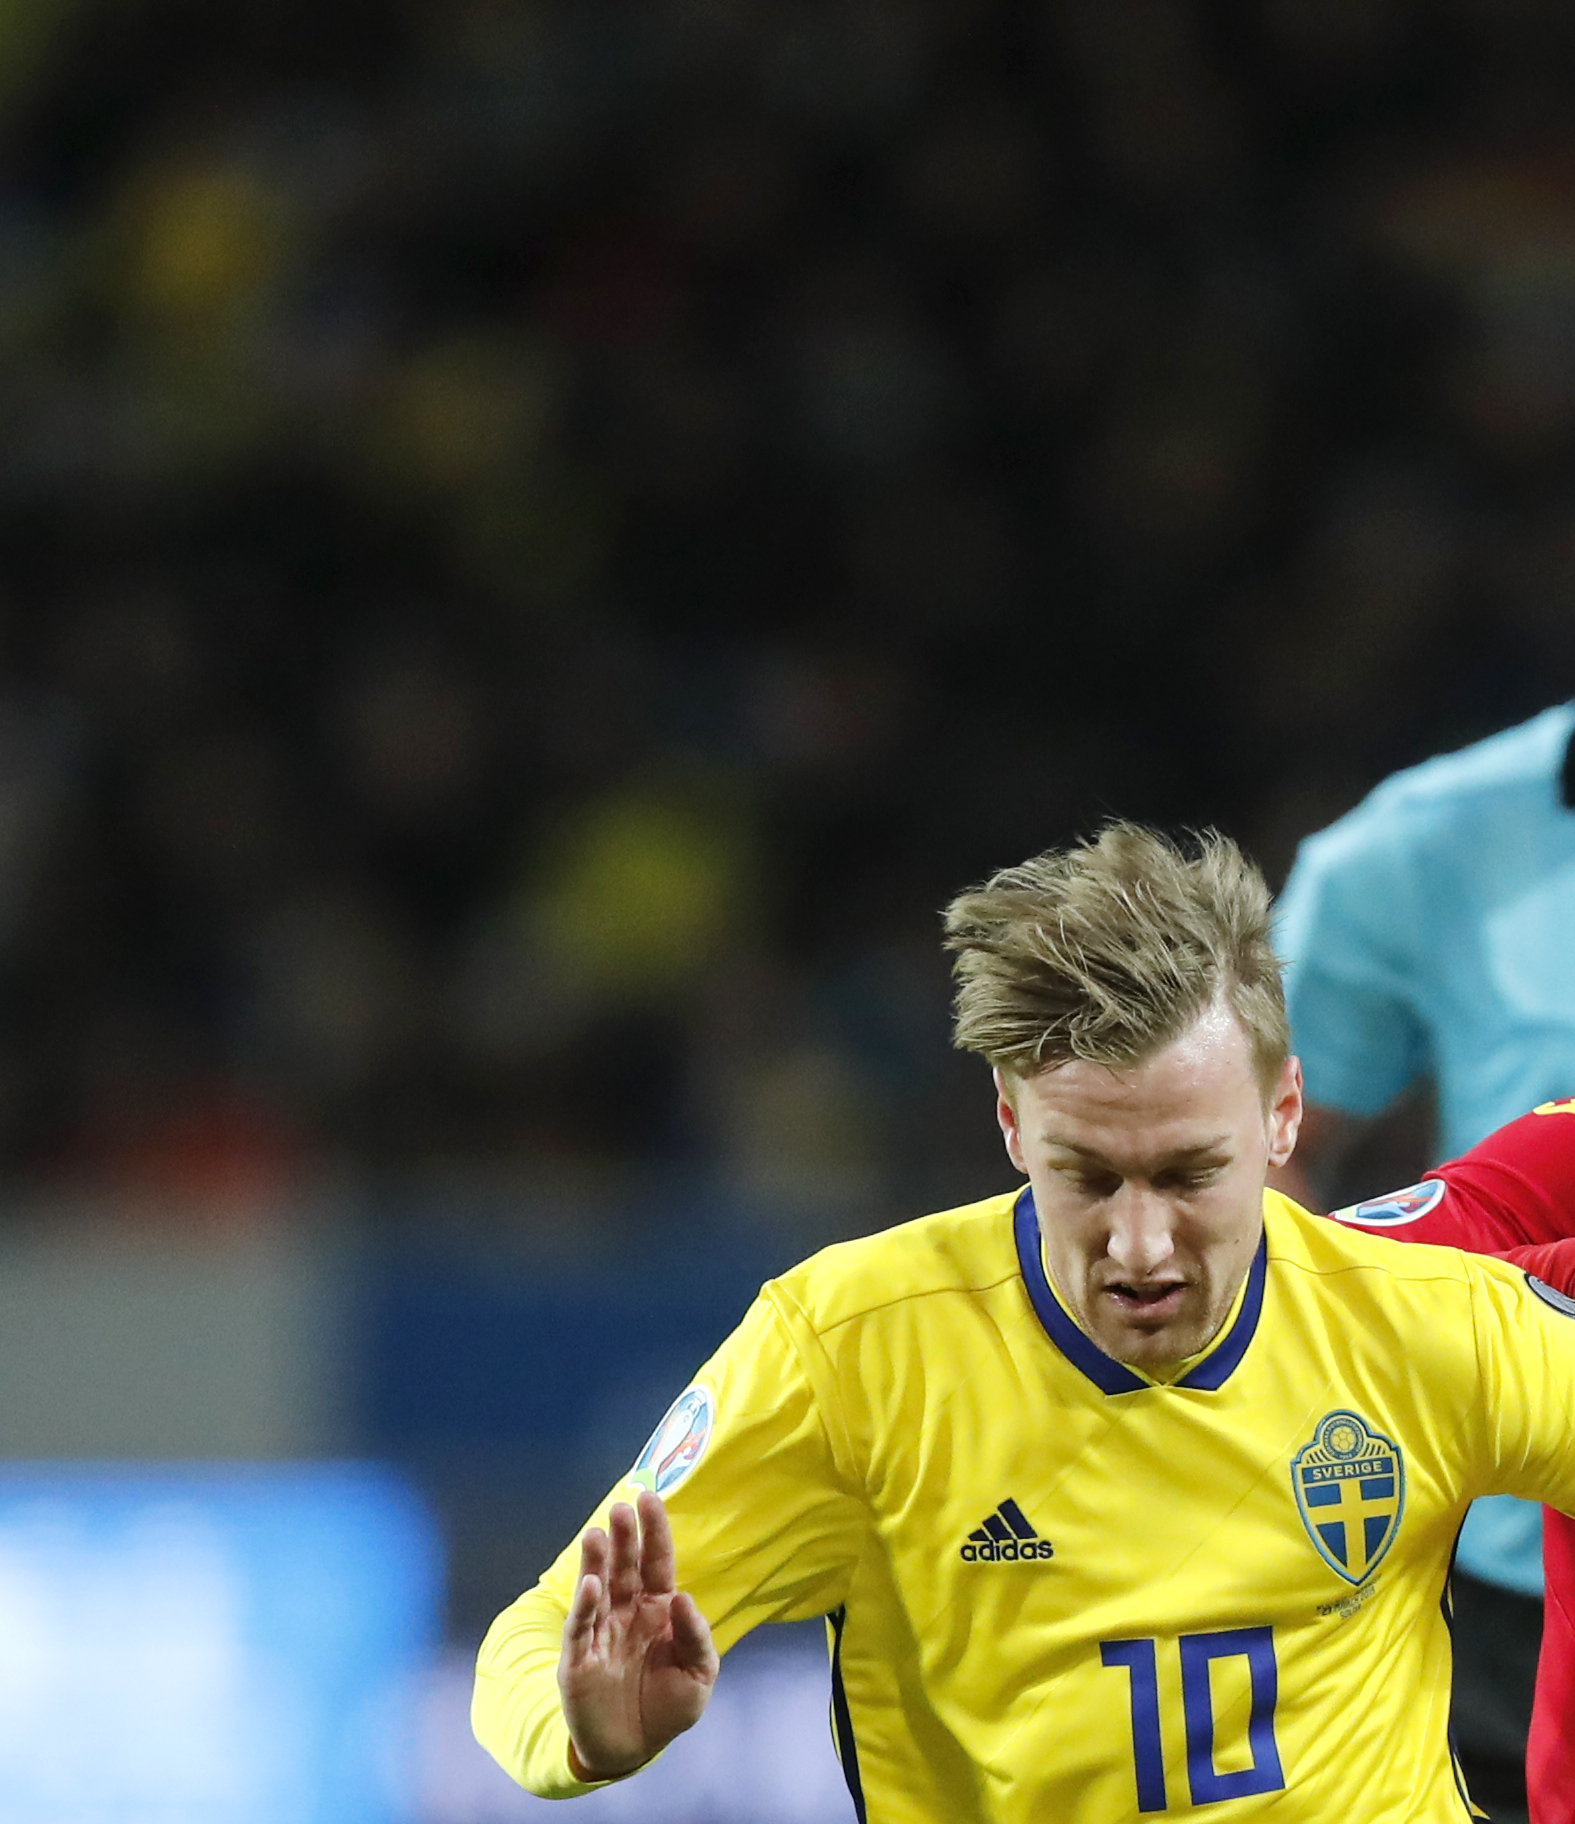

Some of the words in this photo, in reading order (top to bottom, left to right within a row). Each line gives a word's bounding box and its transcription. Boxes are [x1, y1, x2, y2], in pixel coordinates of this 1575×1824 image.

[1312, 1460, 1383, 1480] SVERIGE
[960, 1539, 1054, 1562] adidas
[1100, 1625, 1286, 1813] 10
